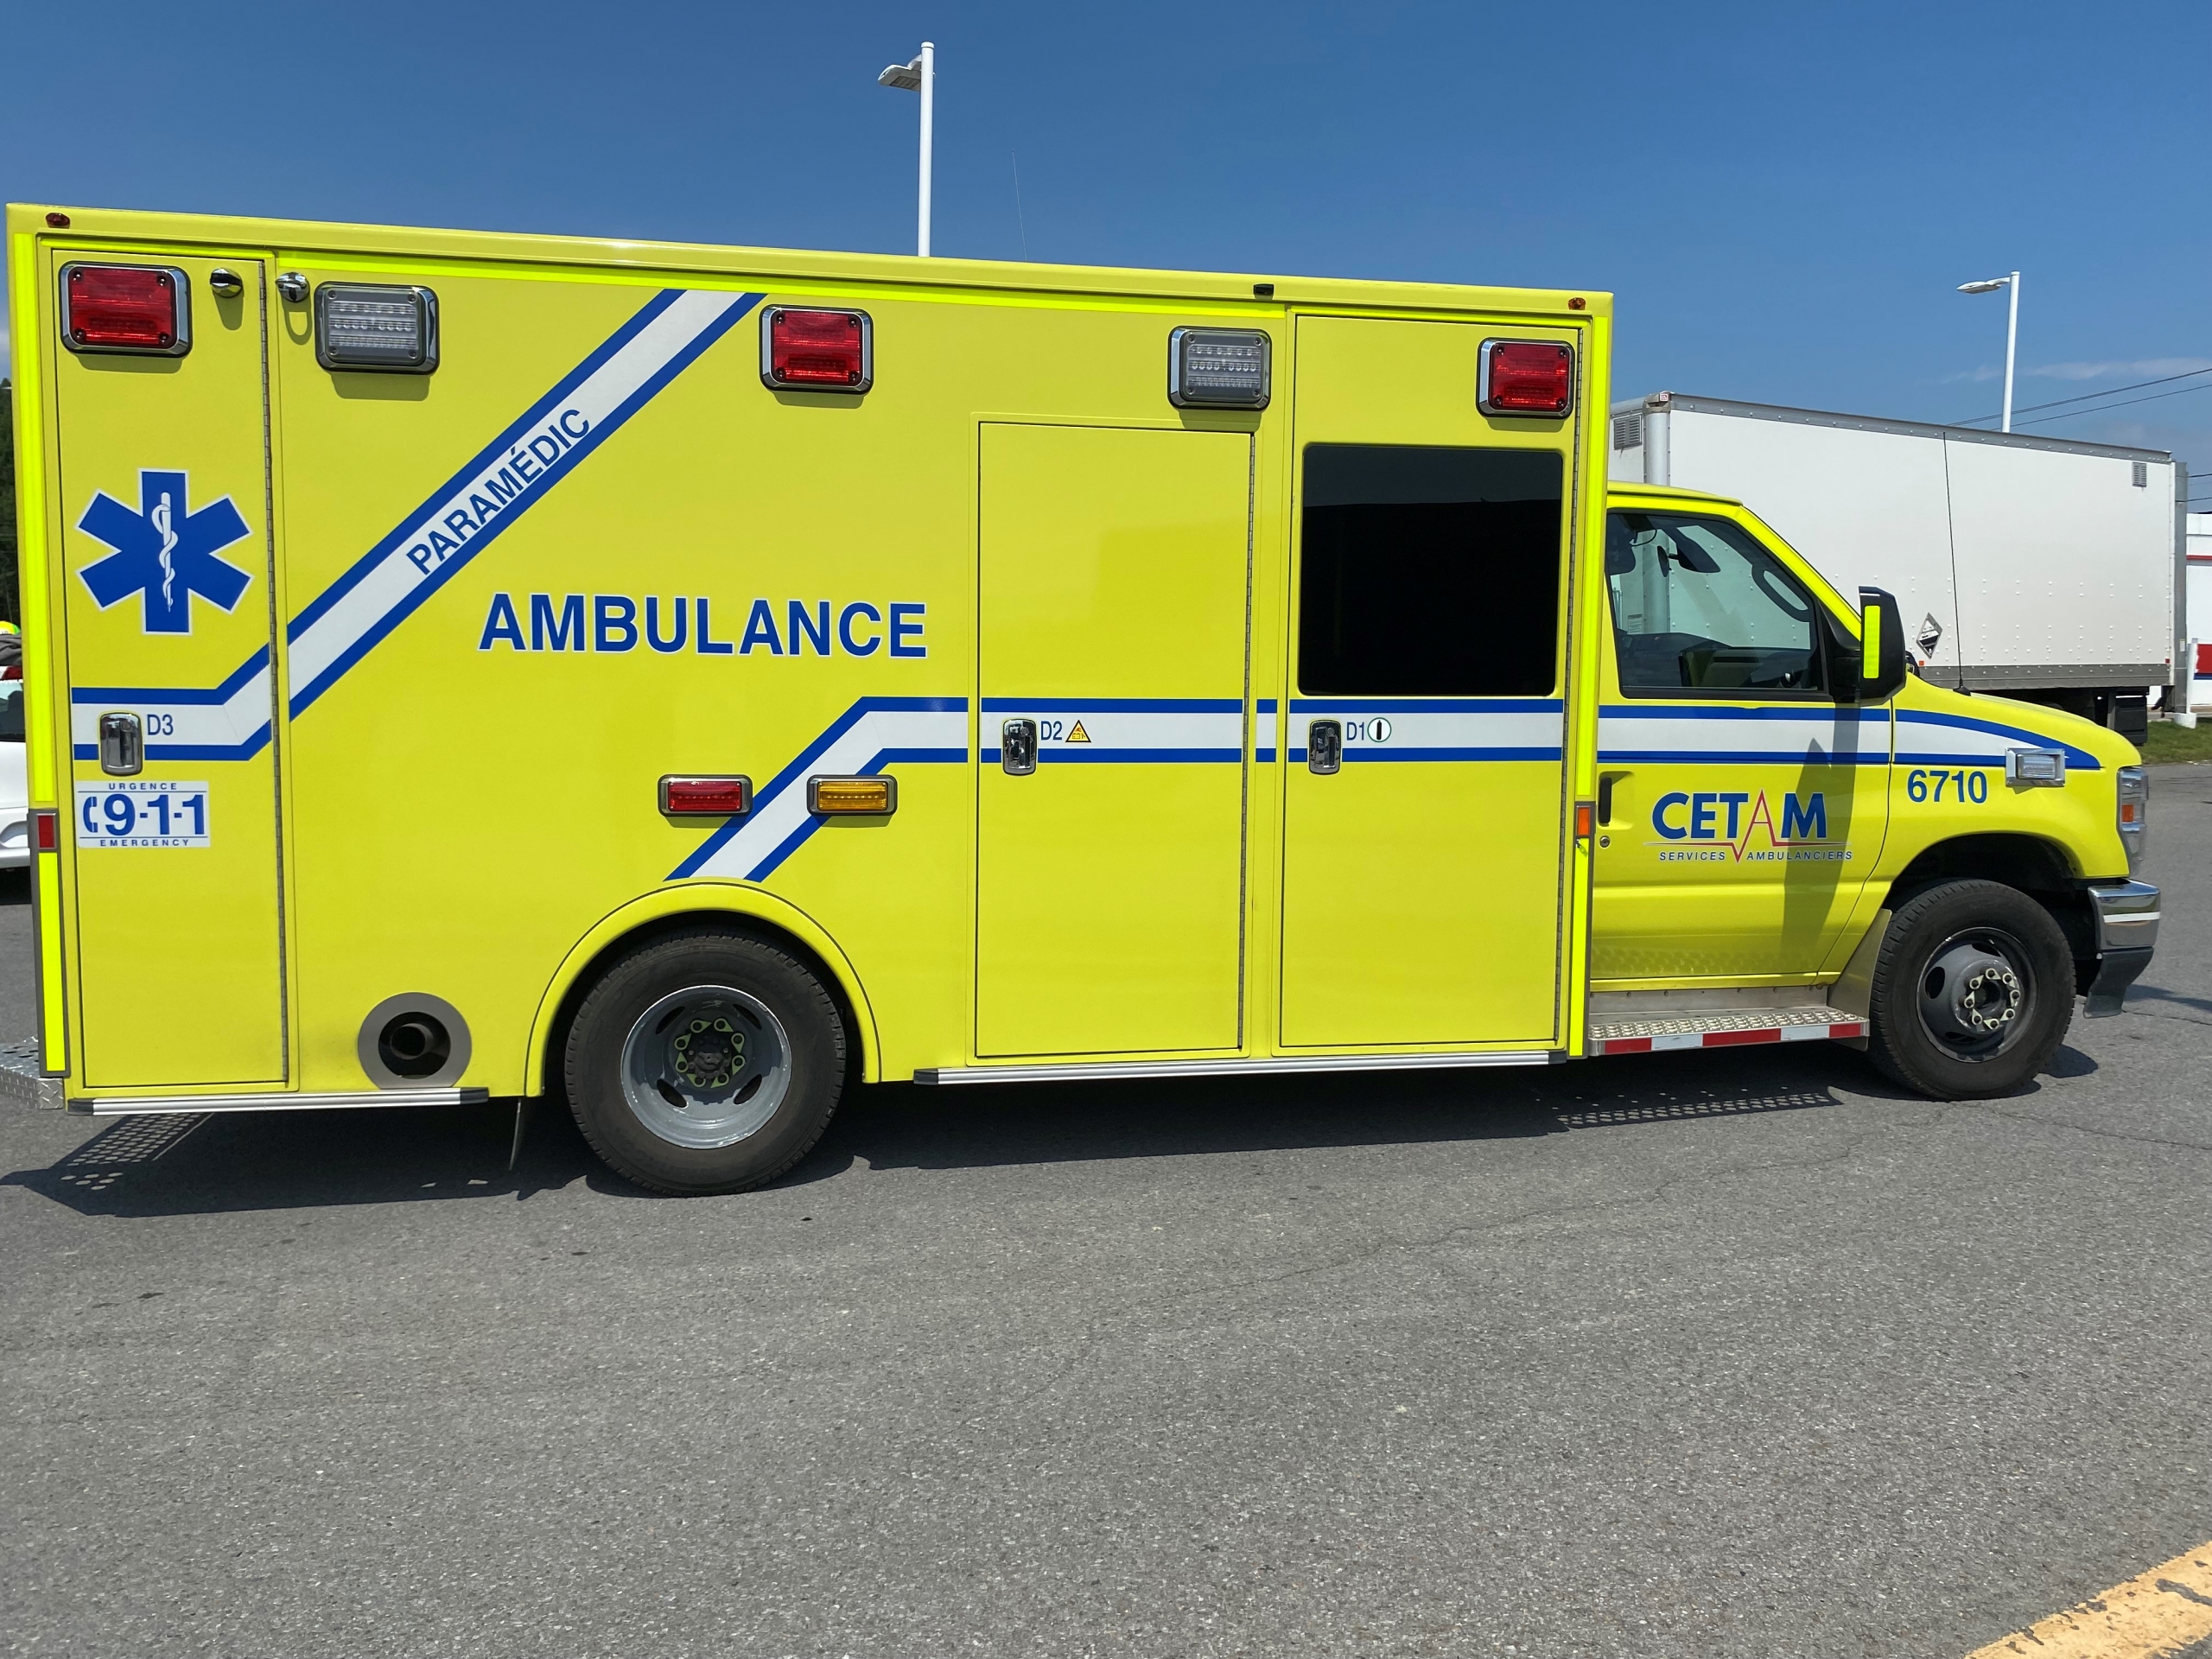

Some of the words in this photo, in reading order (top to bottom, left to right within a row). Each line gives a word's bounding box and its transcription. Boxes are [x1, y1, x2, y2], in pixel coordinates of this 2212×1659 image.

[406, 408, 590, 575] PARAMÉDIC
[480, 593, 927, 658] AMBULANCE
[147, 714, 174, 736] D3
[1040, 721, 1063, 741] D2
[1346, 721, 1364, 741] D1
[109, 782, 177, 791] URGENCE
[1907, 769, 1988, 804] 6710
[104, 793, 205, 836] 9-1-1
[1651, 789, 1827, 847] CETAM
[1659, 851, 1726, 861] SERVICES
[1746, 850, 1853, 861] AMBULANCIERS
